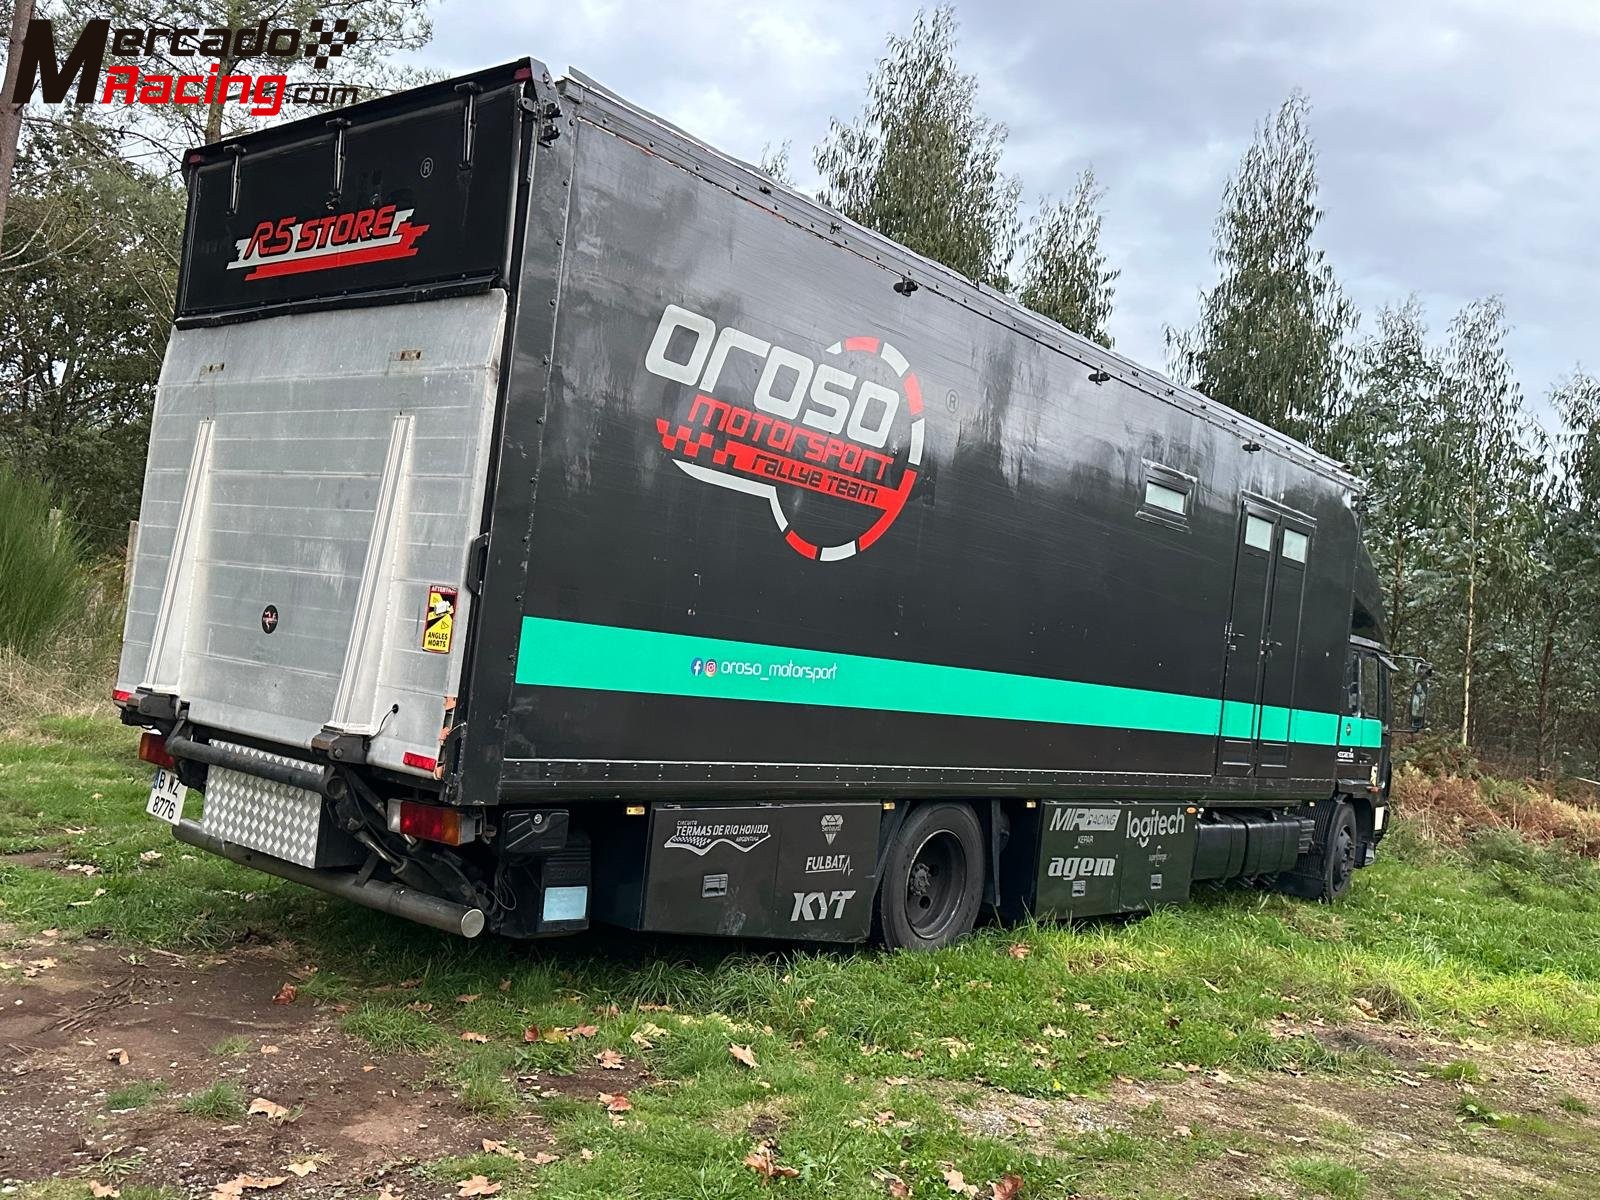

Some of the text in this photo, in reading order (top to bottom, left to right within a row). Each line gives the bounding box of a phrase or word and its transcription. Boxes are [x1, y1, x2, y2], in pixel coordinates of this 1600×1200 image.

[295, 204, 397, 252] STORE
[427, 631, 448, 641] ANGLES
[427, 639, 446, 648] MORTS
[720, 659, 838, 684] oroso_motorsport
[158, 771, 166, 789] B
[152, 795, 176, 820] 8776
[676, 825, 713, 836] TERMAS
[712, 825, 725, 836] DE
[724, 825, 740, 835] RIO
[1126, 807, 1185, 848] logitech
[805, 855, 846, 871] FULBAT
[1047, 857, 1116, 881] agem
[790, 890, 857, 921] KYT
